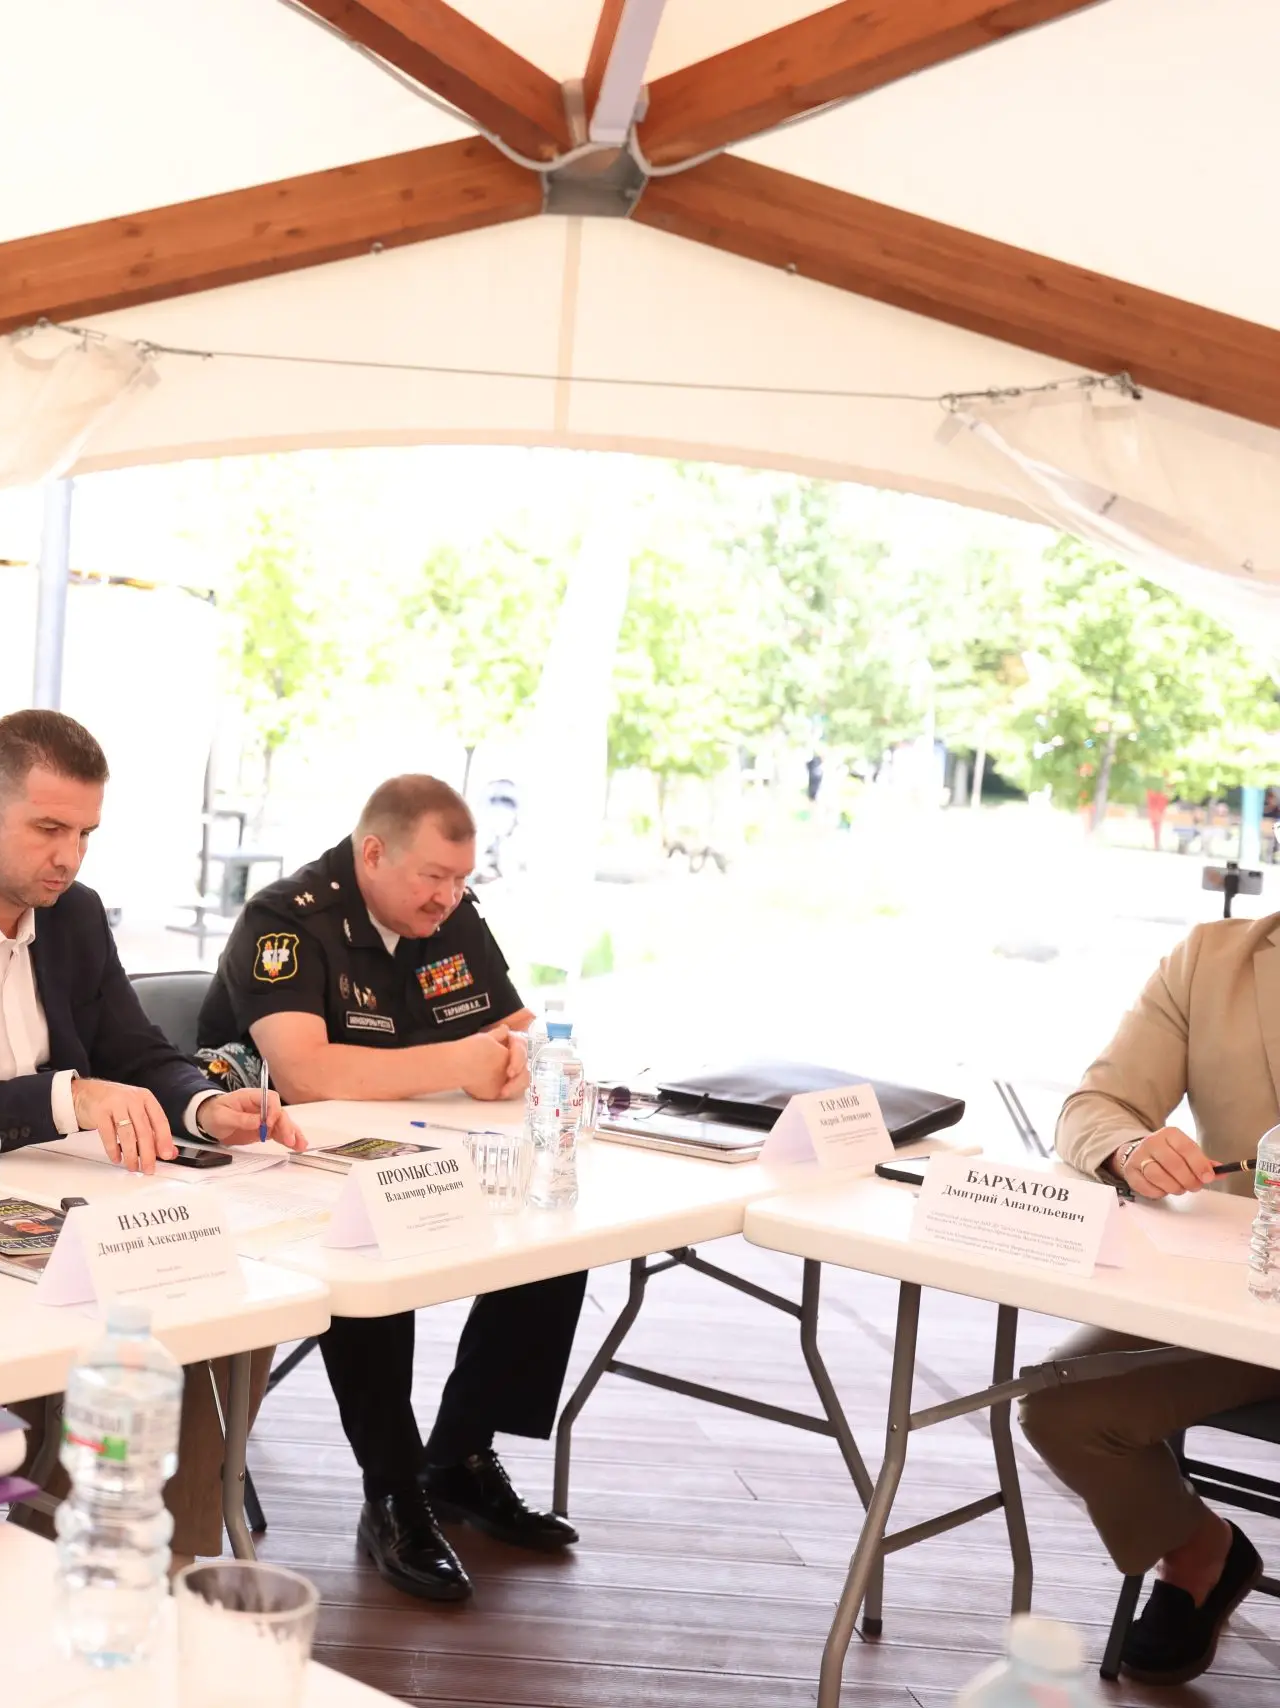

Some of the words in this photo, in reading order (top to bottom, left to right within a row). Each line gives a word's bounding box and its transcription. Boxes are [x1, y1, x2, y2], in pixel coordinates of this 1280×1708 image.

[819, 1095, 860, 1112] ТАРАНОВ
[376, 1159, 459, 1186] ПРОМЫСЛОВ
[966, 1169, 1070, 1202] БАРХАТОВ
[385, 1187, 426, 1202] Владимир
[426, 1180, 464, 1196] Юрьевич
[941, 1184, 998, 1204] Дмитрий
[1000, 1196, 1085, 1223] Анатольевич
[117, 1205, 190, 1231] НАЗАРОВ
[98, 1236, 145, 1257] Дмитрий
[147, 1225, 221, 1249] Александрович
